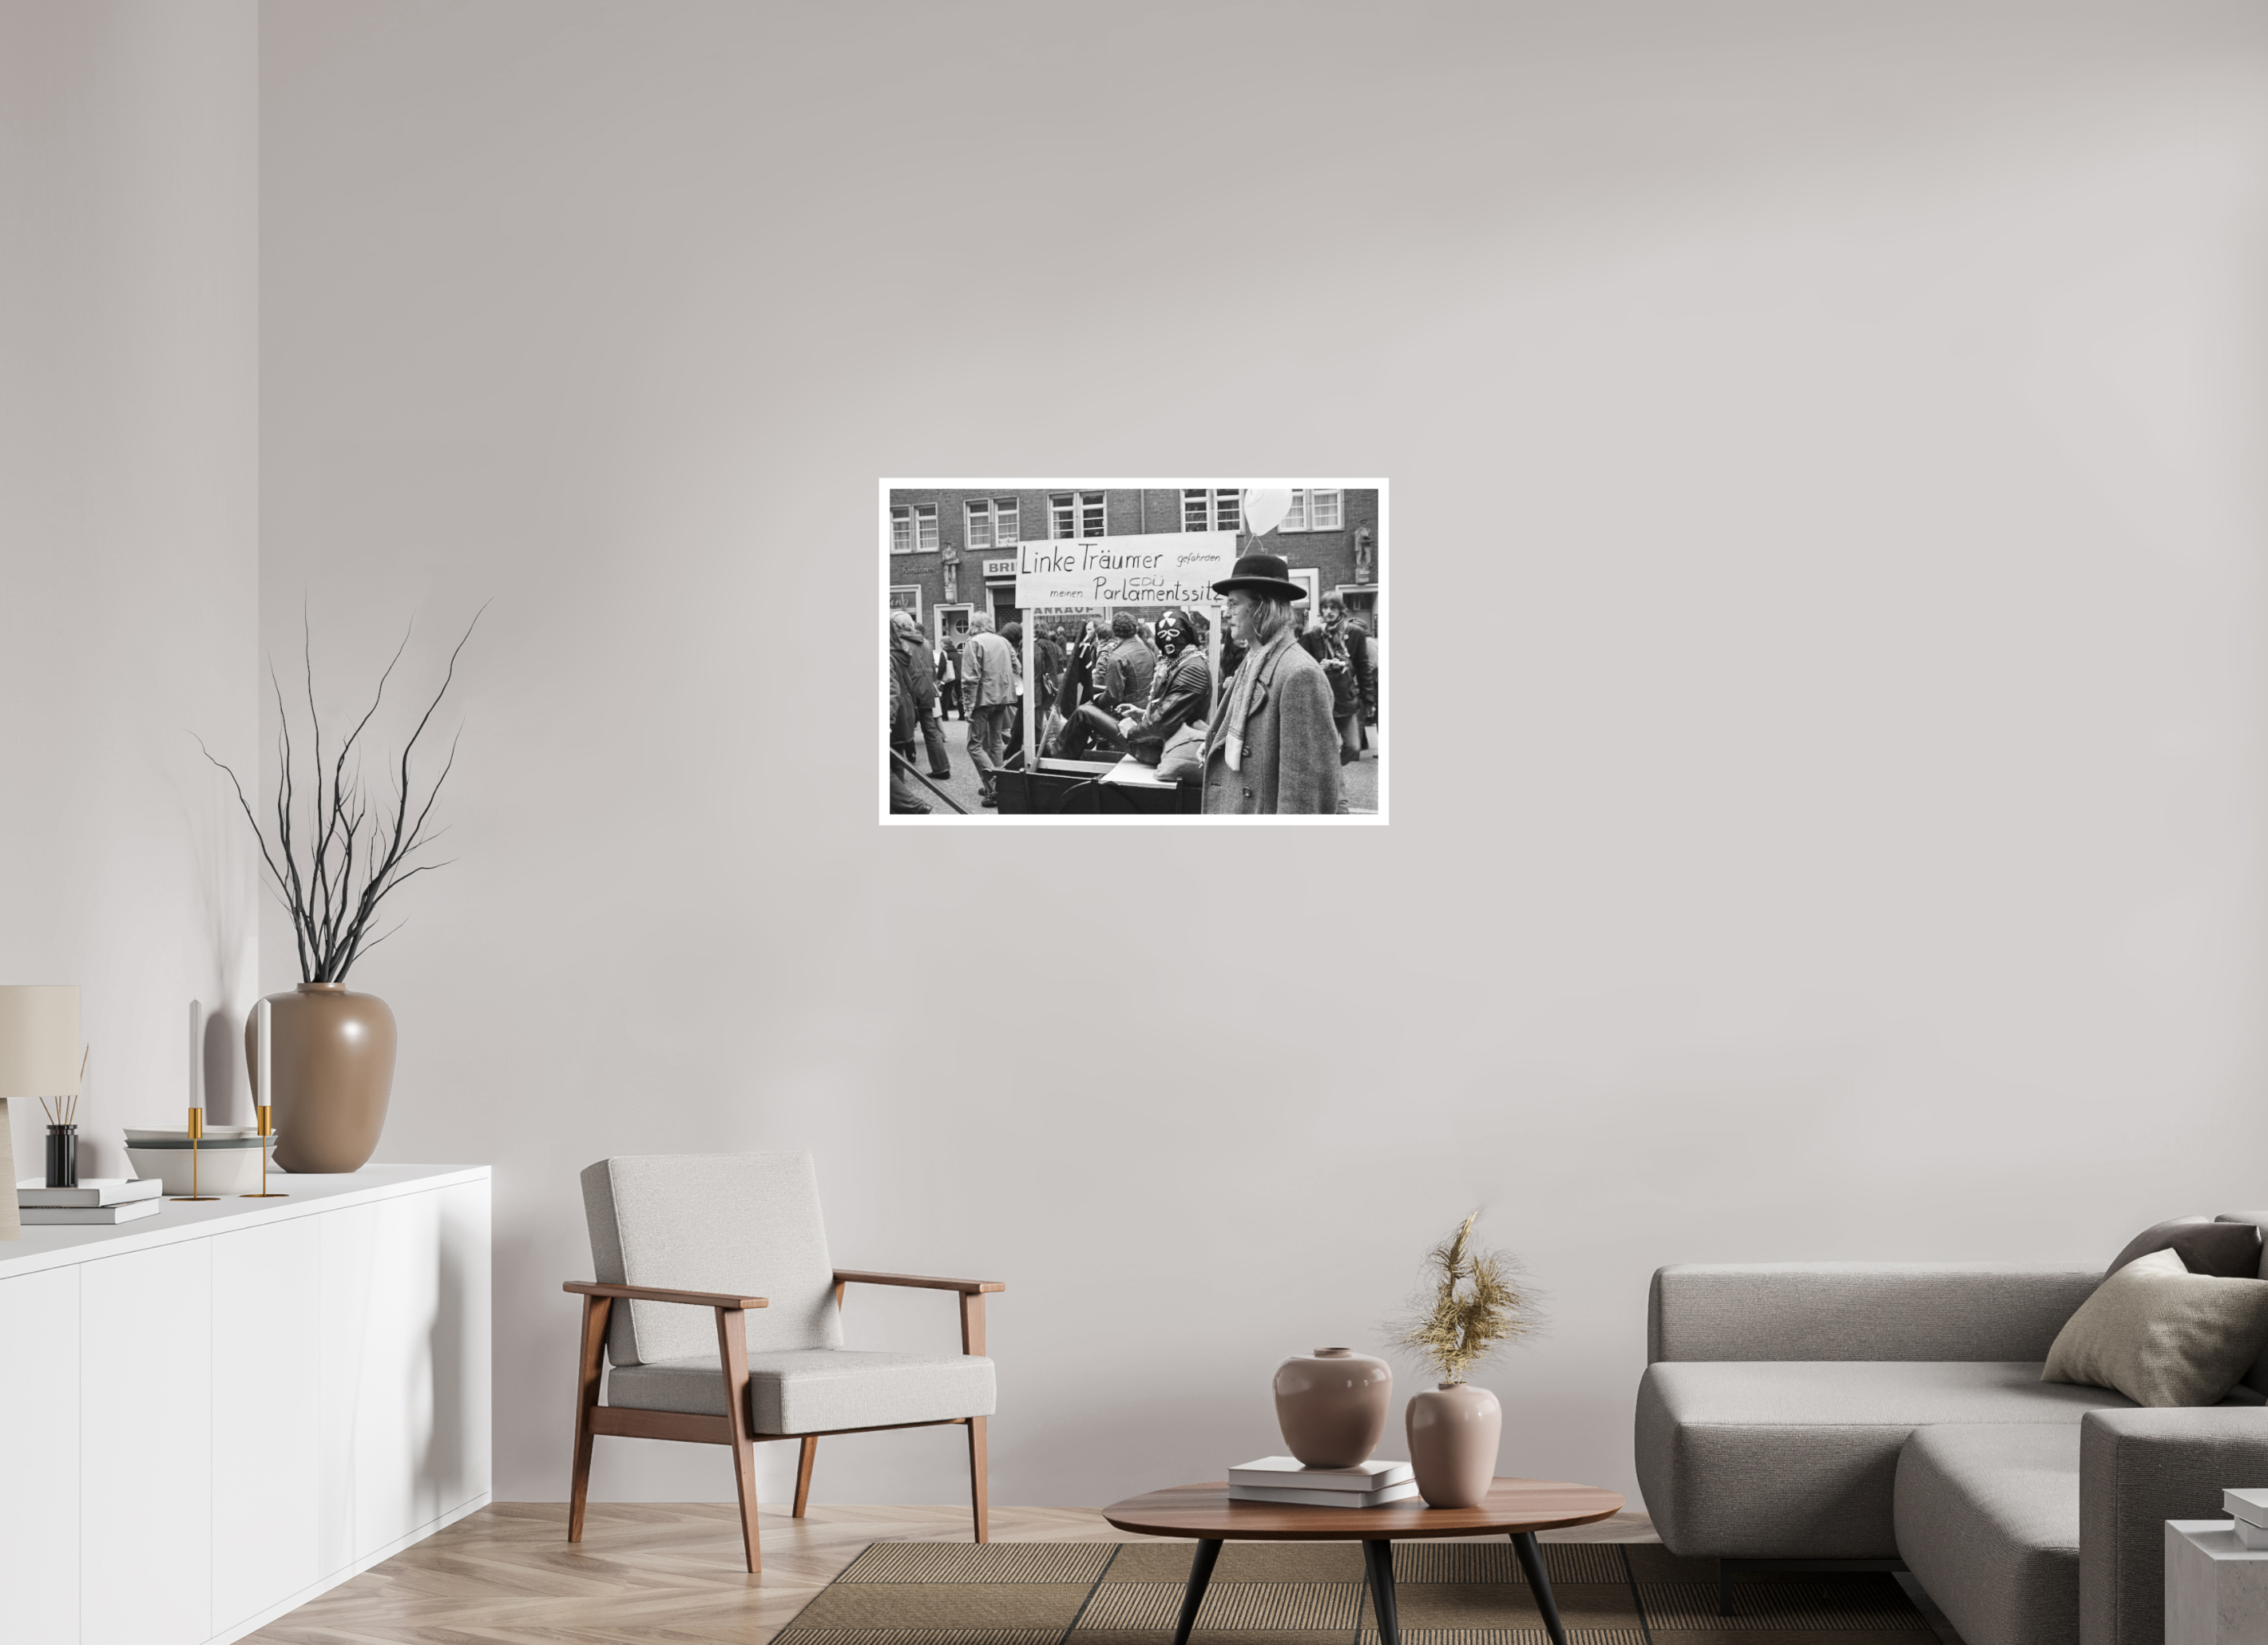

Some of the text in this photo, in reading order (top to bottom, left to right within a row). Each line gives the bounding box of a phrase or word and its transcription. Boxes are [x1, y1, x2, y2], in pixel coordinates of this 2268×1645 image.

[989, 562, 1017, 573] BRI
[1021, 545, 1075, 574] Linke
[1078, 543, 1164, 571] Träumer
